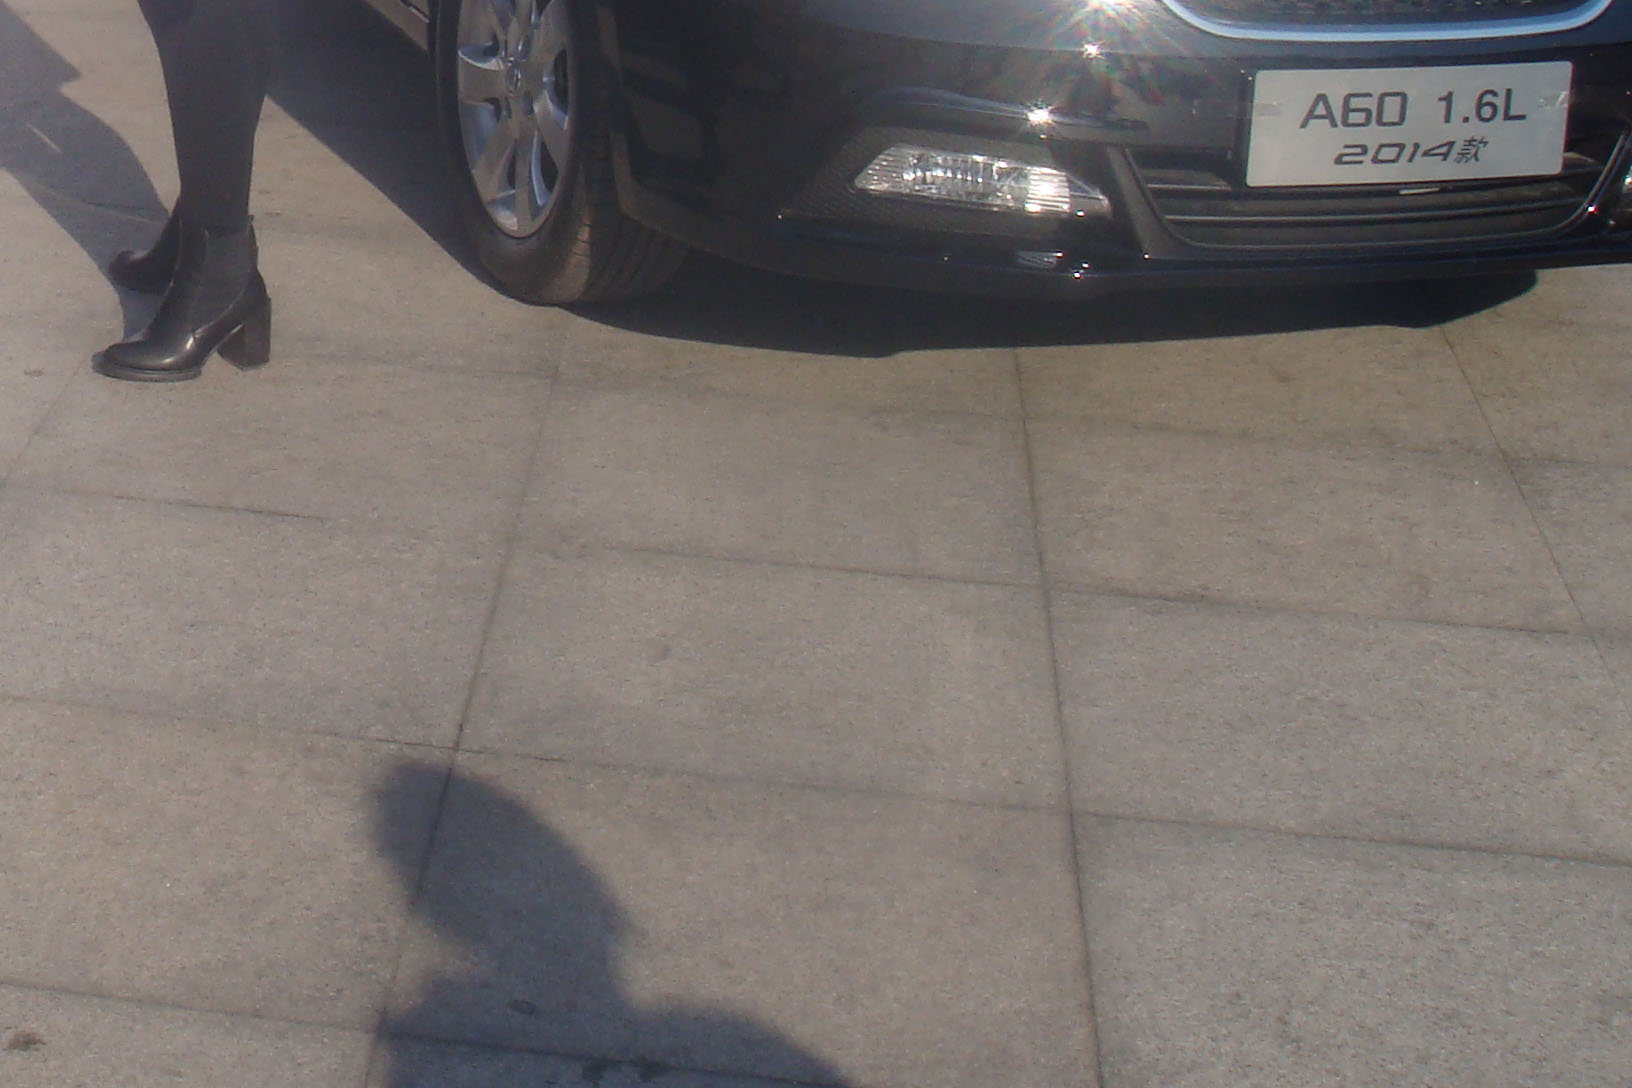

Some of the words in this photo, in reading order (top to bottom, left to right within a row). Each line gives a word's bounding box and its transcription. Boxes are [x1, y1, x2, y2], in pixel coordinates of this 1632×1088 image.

[1298, 89, 1408, 129] A60
[1438, 87, 1528, 124] 1.6L
[1333, 136, 1490, 167] 2014款
